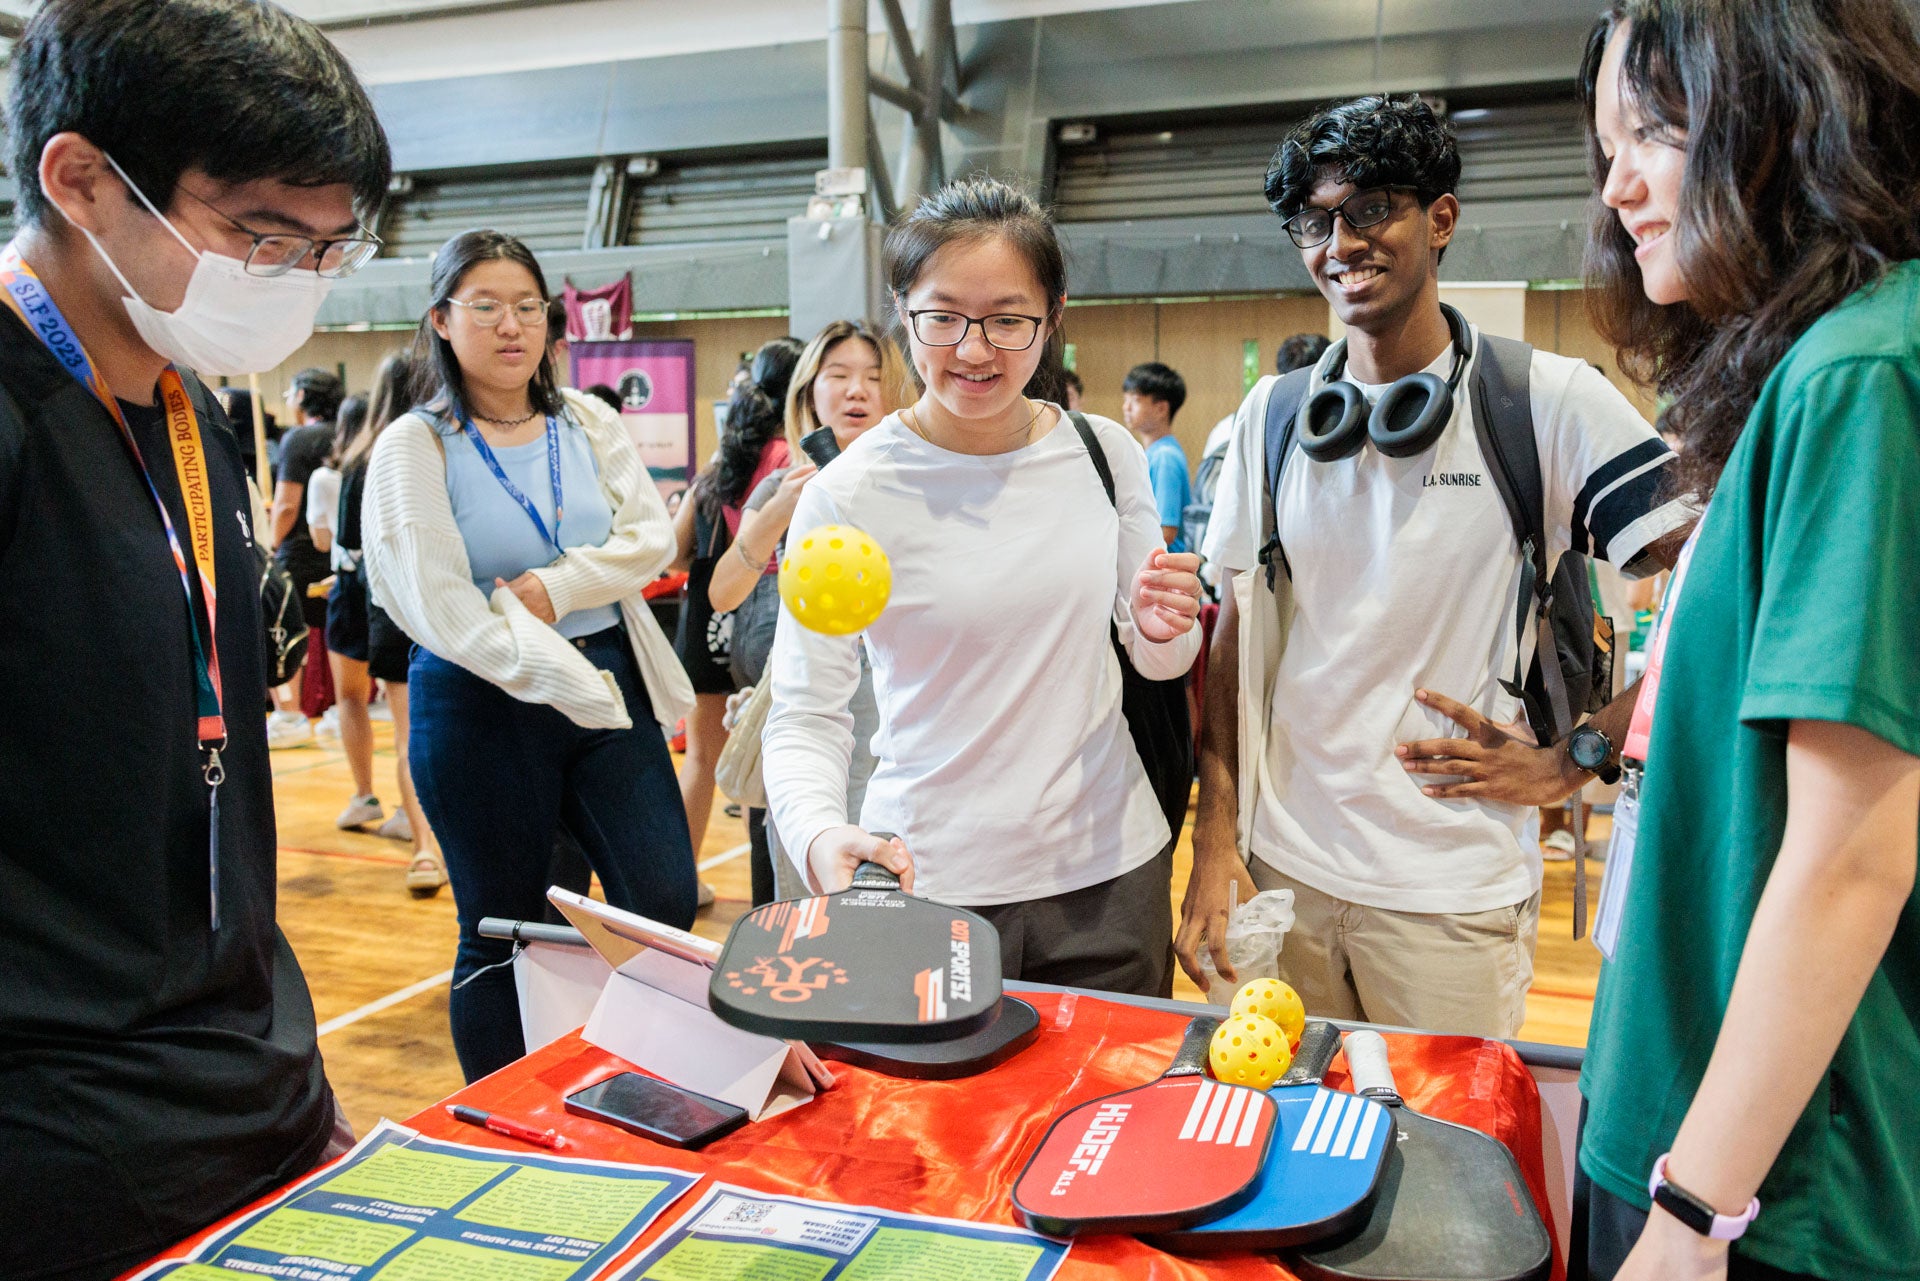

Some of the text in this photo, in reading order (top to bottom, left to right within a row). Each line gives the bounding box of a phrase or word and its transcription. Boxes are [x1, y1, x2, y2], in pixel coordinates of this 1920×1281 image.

[16, 282, 84, 368] SLF 2023
[168, 389, 209, 561] PARTICIPATING BODIES
[1439, 473, 1482, 487] SUNRISE
[1068, 1104, 1132, 1176] HUDEF
[330, 1202, 360, 1212] PLAY
[364, 1207, 389, 1218] CAN
[369, 1201, 438, 1217] PICKLEBALL?
[387, 1212, 427, 1224] WHERE
[802, 1220, 861, 1235] OUR TELEGRAM
[460, 1231, 591, 1258] WHAT ARE THE PADDLES
[543, 1235, 601, 1250] MADE OF?
[818, 1236, 849, 1248] FOLLOW
[223, 1258, 289, 1276] PICKLEBALL
[345, 1264, 363, 1275] IN
[299, 1270, 323, 1281] BIG
